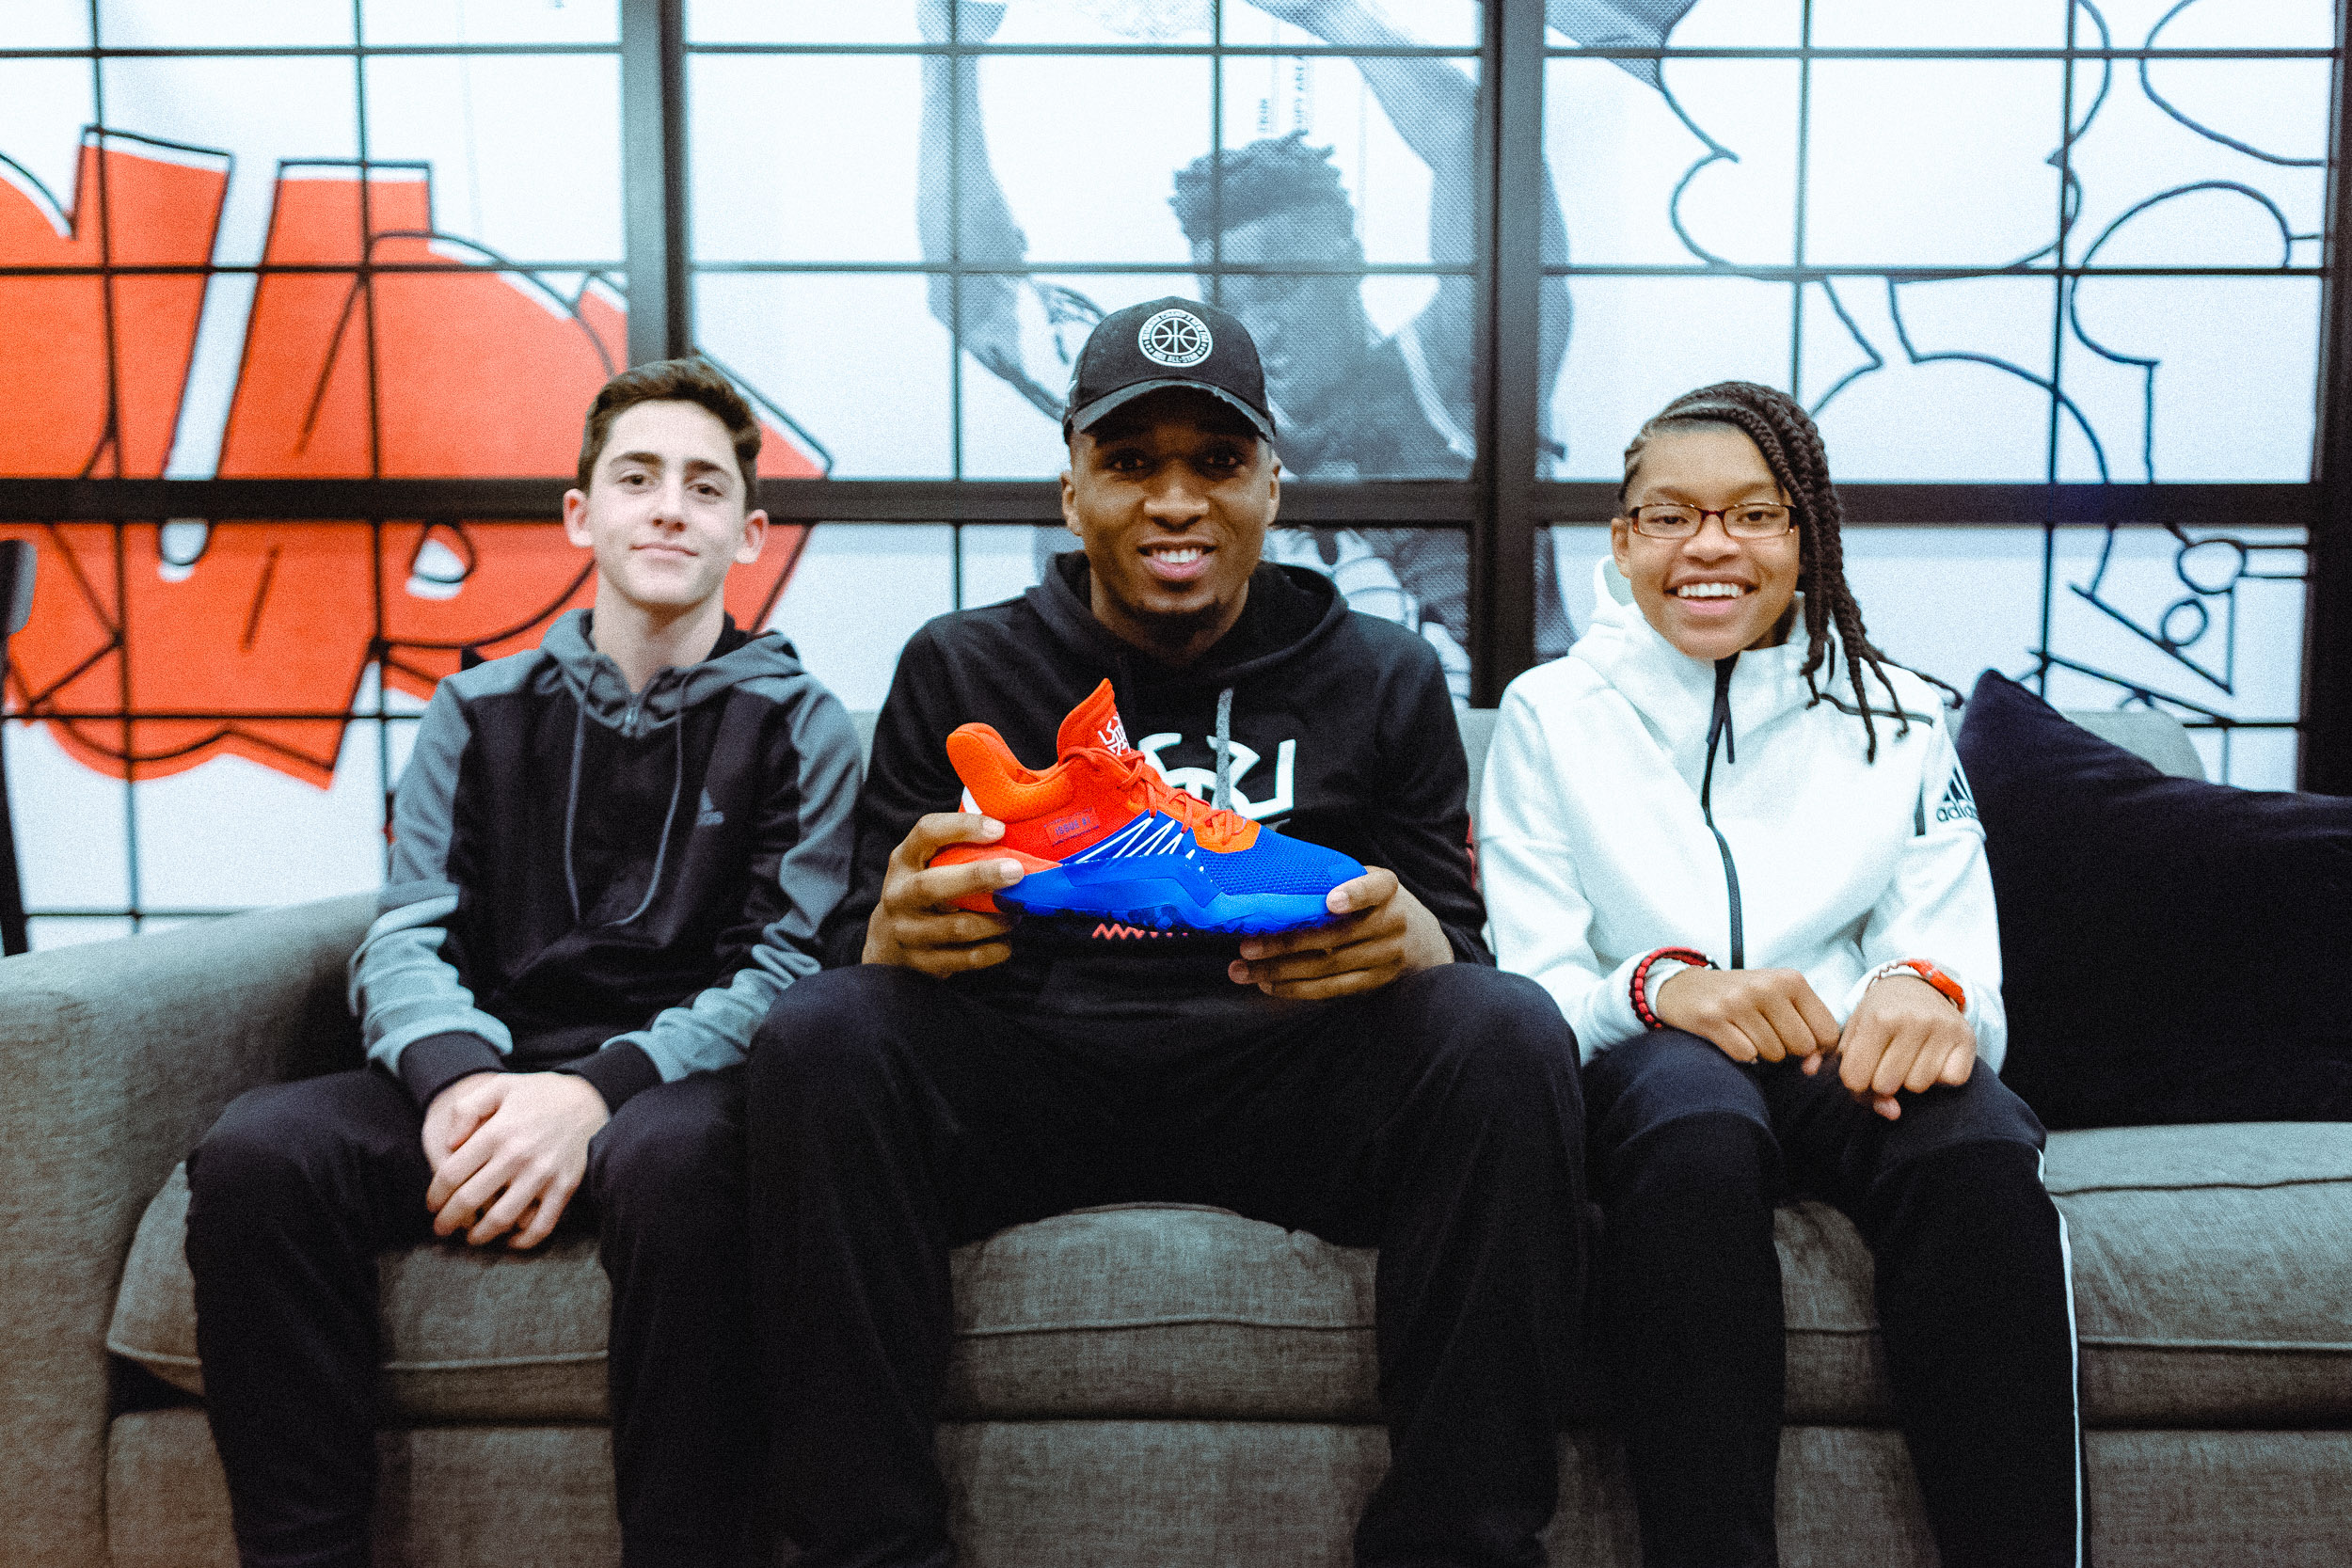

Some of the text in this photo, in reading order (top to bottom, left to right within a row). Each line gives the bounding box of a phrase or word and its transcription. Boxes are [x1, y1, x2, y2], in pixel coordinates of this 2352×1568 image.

[1167, 352, 1200, 363] ALL-STAR
[1936, 800, 1979, 822] adid
[1055, 819, 1080, 836] ISSUE
